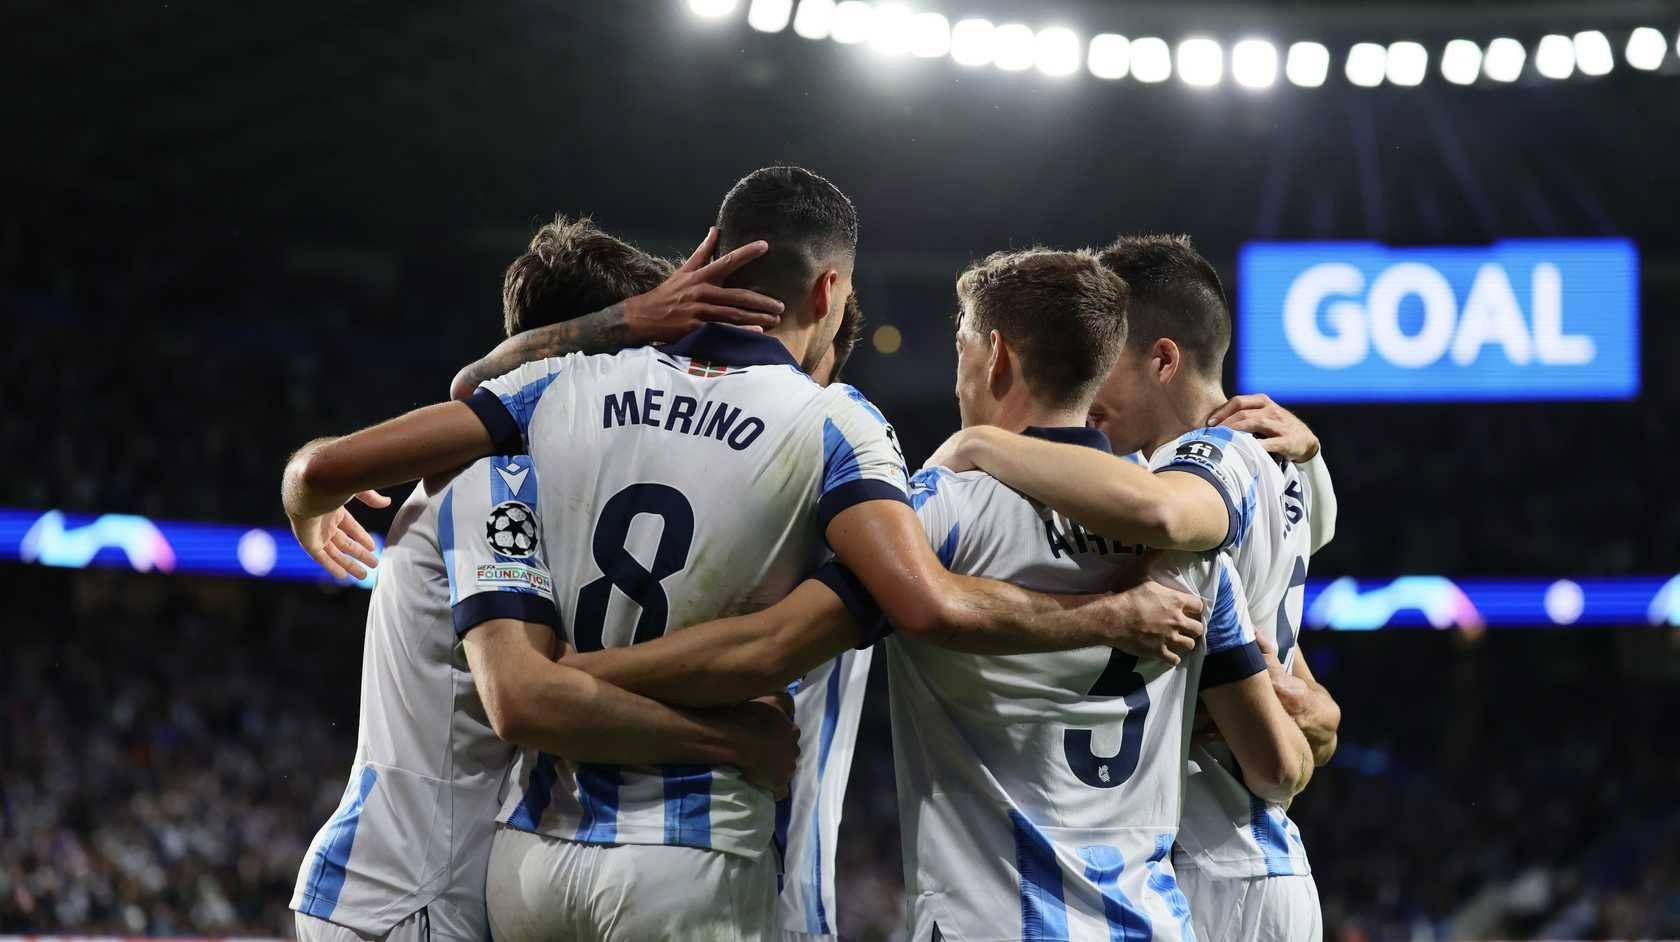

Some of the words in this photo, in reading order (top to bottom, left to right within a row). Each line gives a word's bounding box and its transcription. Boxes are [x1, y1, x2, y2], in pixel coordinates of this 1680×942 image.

[1283, 262, 1596, 368] GOAL
[603, 388, 766, 451] MERINO
[477, 568, 550, 590] FOUNDATION
[574, 483, 695, 653] 8
